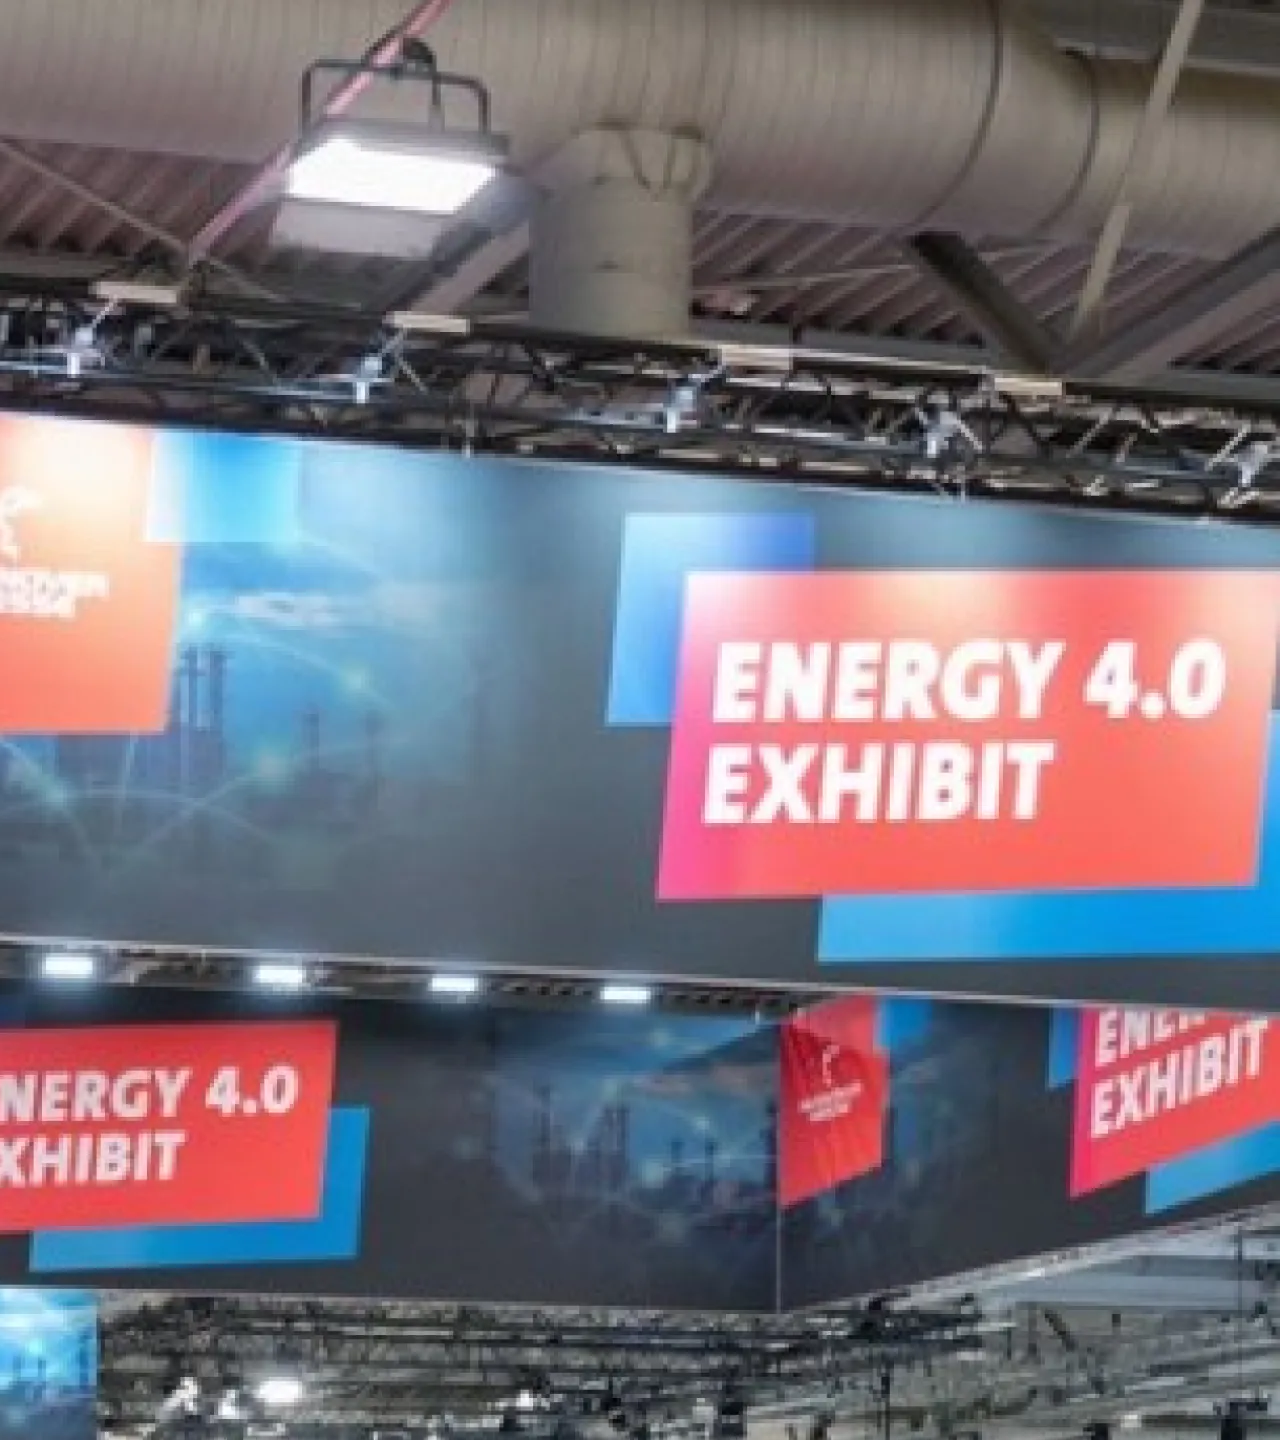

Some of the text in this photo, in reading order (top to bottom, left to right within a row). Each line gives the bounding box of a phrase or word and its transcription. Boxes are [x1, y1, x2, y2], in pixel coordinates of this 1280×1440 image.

[712, 638, 1227, 723] ENERGY 4.0
[702, 741, 1057, 824] EXHIBIT
[203, 1062, 301, 1118] 4.0
[1090, 1016, 1270, 1139] EXHIBIT
